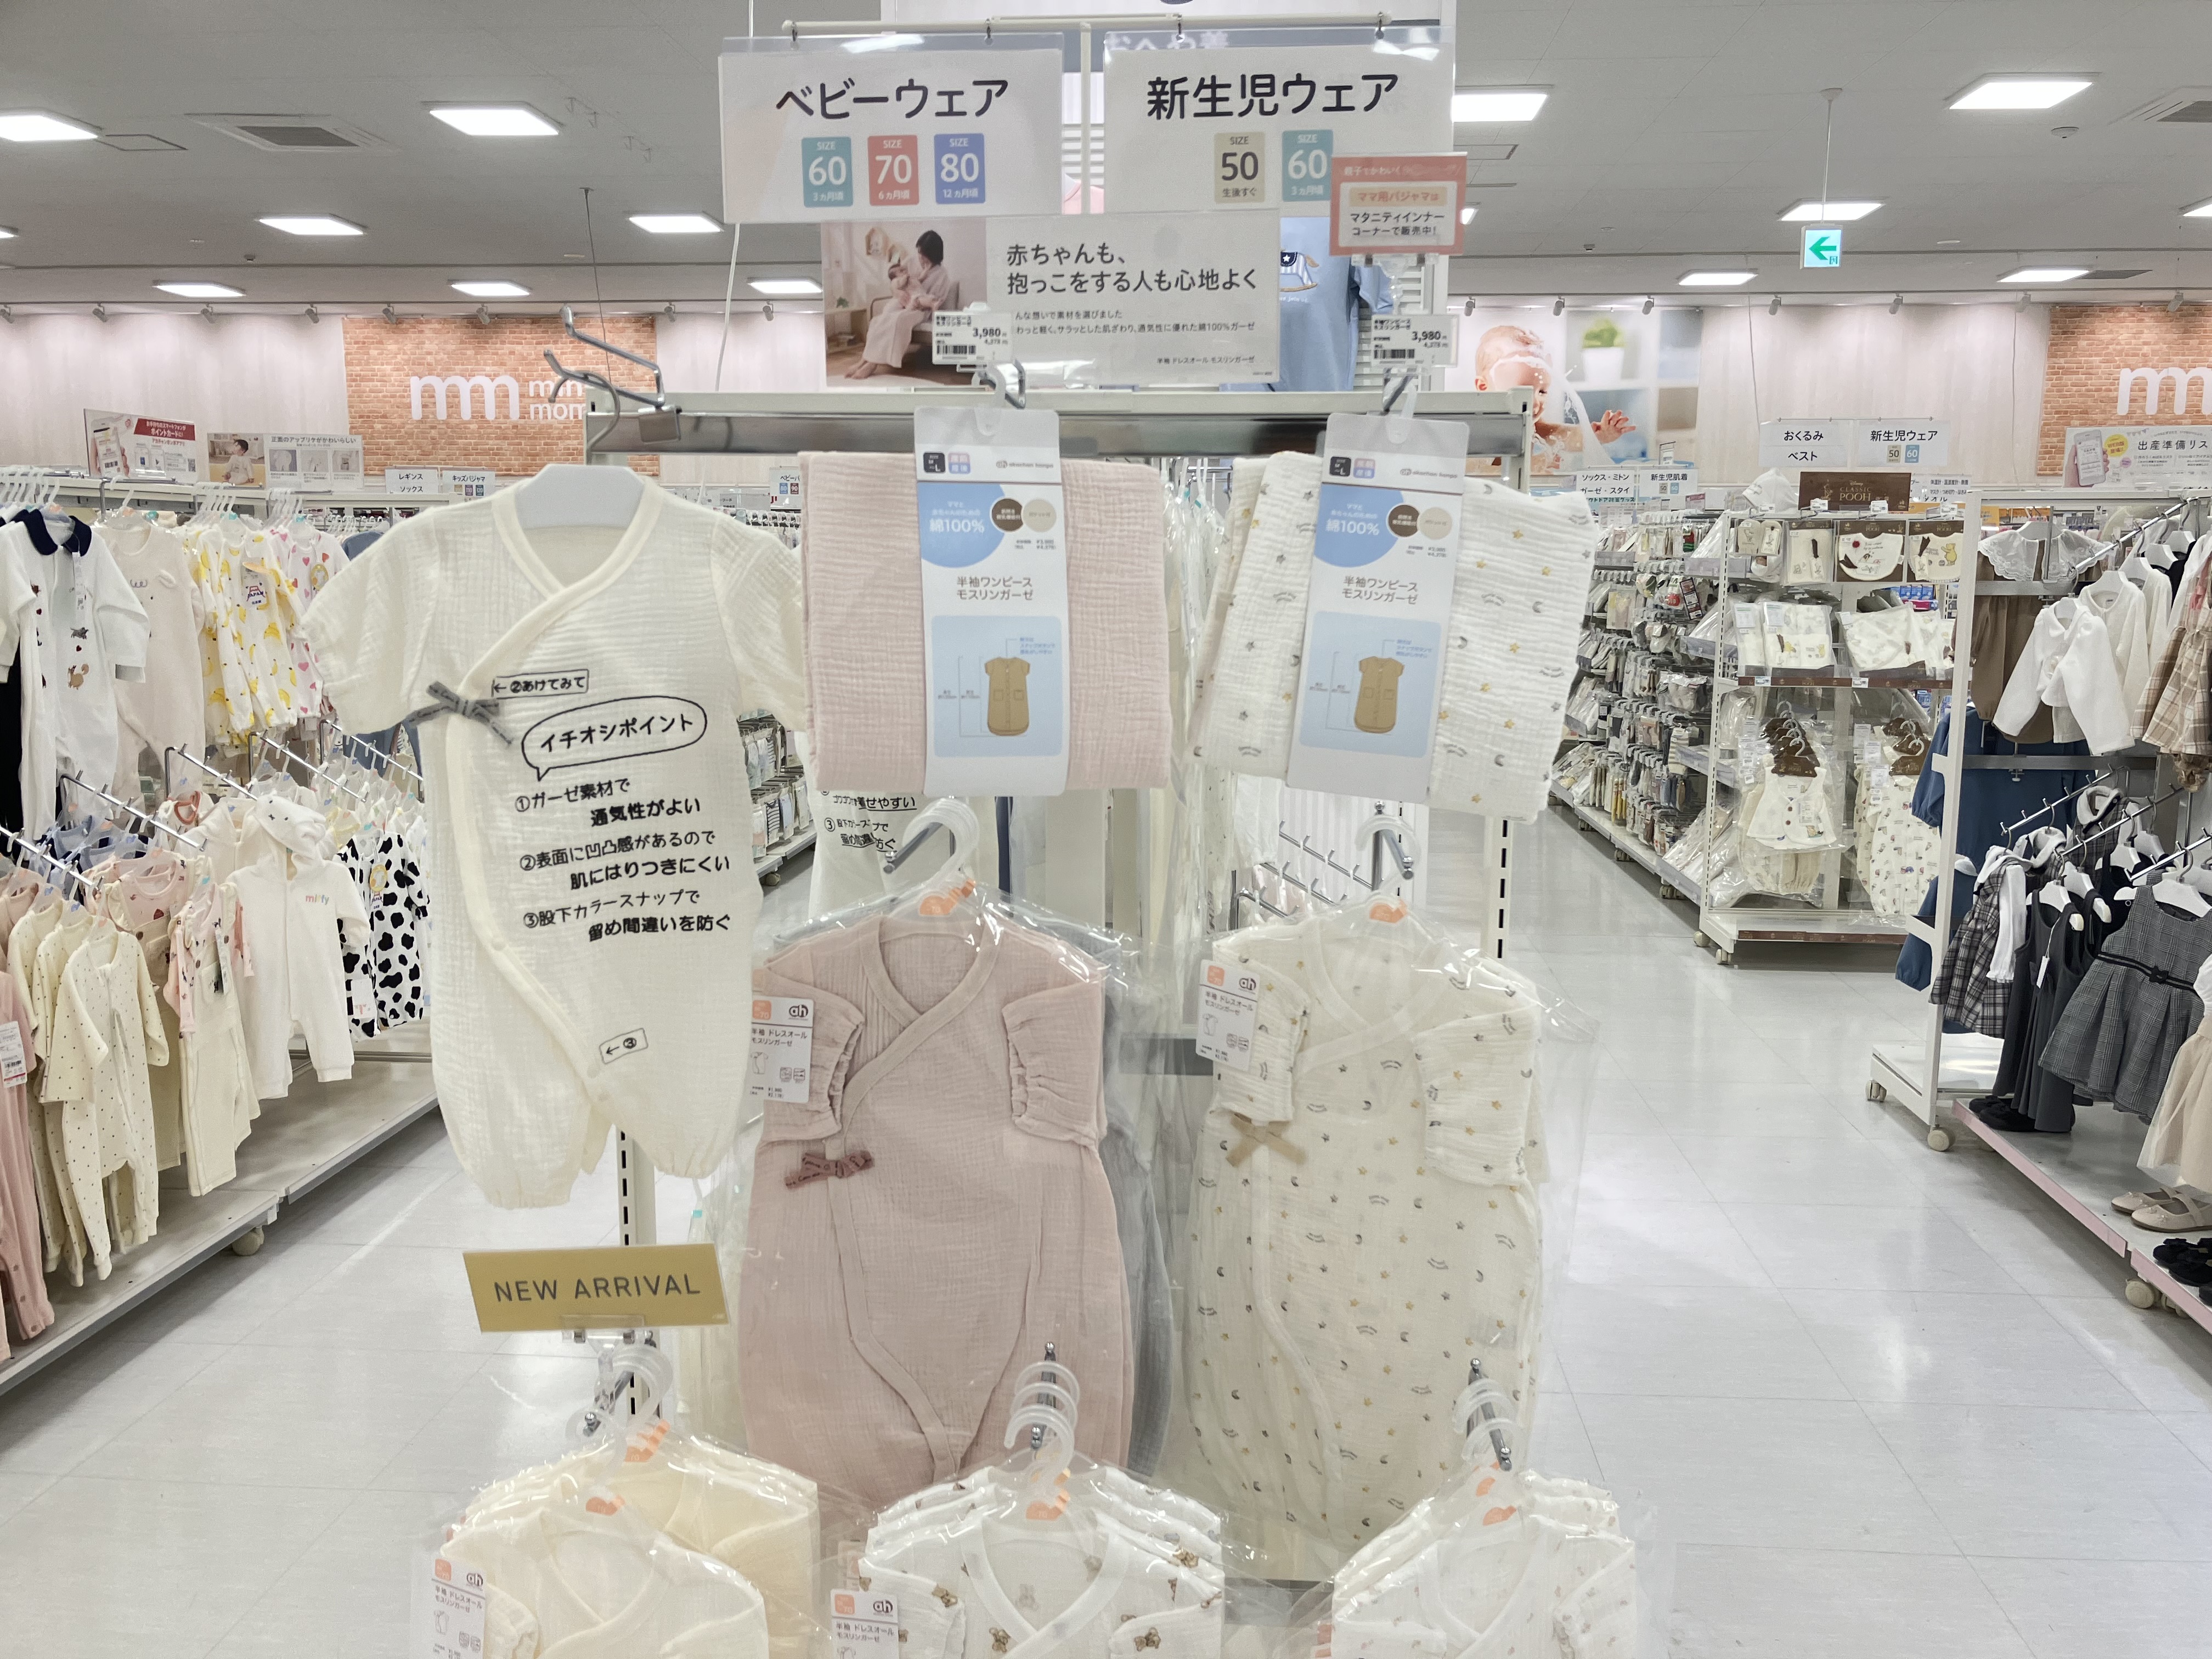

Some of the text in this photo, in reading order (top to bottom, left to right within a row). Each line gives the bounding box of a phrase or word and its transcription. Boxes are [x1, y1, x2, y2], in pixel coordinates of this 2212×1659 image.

[776, 78, 1008, 119] ベビーウェア
[1147, 73, 1398, 120] 新生児ウェア
[817, 141, 836, 150] SIZE
[883, 140, 902, 149] SIZE
[950, 138, 968, 147] SIZE
[1230, 136, 1249, 145] SIZE
[809, 156, 846, 185] 60
[876, 155, 912, 184] 70
[940, 153, 979, 183] 80
[1222, 151, 1259, 180] 50
[1288, 149, 1328, 179] 60
[1222, 188, 1256, 198] 生後すぐ
[1358, 191, 1439, 202] ママ用パジャマは
[1350, 211, 1445, 223] マタニティインナー
[1007, 243, 1126, 267] 赤ちゃんも、
[1007, 268, 1257, 295] 抱っこをする人も心地よく
[1784, 430, 1824, 441] おくるみ
[1870, 430, 1938, 442] 新生児ウェア
[2138, 440, 2212, 450] 出産準備リス
[1787, 451, 1818, 461] ベスト
[930, 518, 984, 533] 綿100%
[1326, 519, 1379, 535] 綿100%
[957, 577, 1032, 588] 半袖ワンピース
[1344, 576, 1418, 592] 半袖ワンピース
[957, 589, 1033, 600] モスリンガーゼ
[1342, 588, 1418, 604] モスリンガーゼ
[541, 714, 692, 752] イチオシポイント
[515, 778, 630, 812] ①ガーゼ素材で
[591, 798, 700, 827] 通気性がよい
[520, 831, 715, 871] ②表面に凹凸感があるので
[571, 856, 730, 890] 肌にはりつきにくい
[523, 889, 700, 928] ③股下カラースナップで
[589, 914, 731, 941] 留め間違いを防ぐ
[769, 1029, 807, 1039] ドレスオール
[752, 1038, 792, 1047] モスリンガーゼ
[494, 1273, 701, 1302] NEW ARRIVAL
